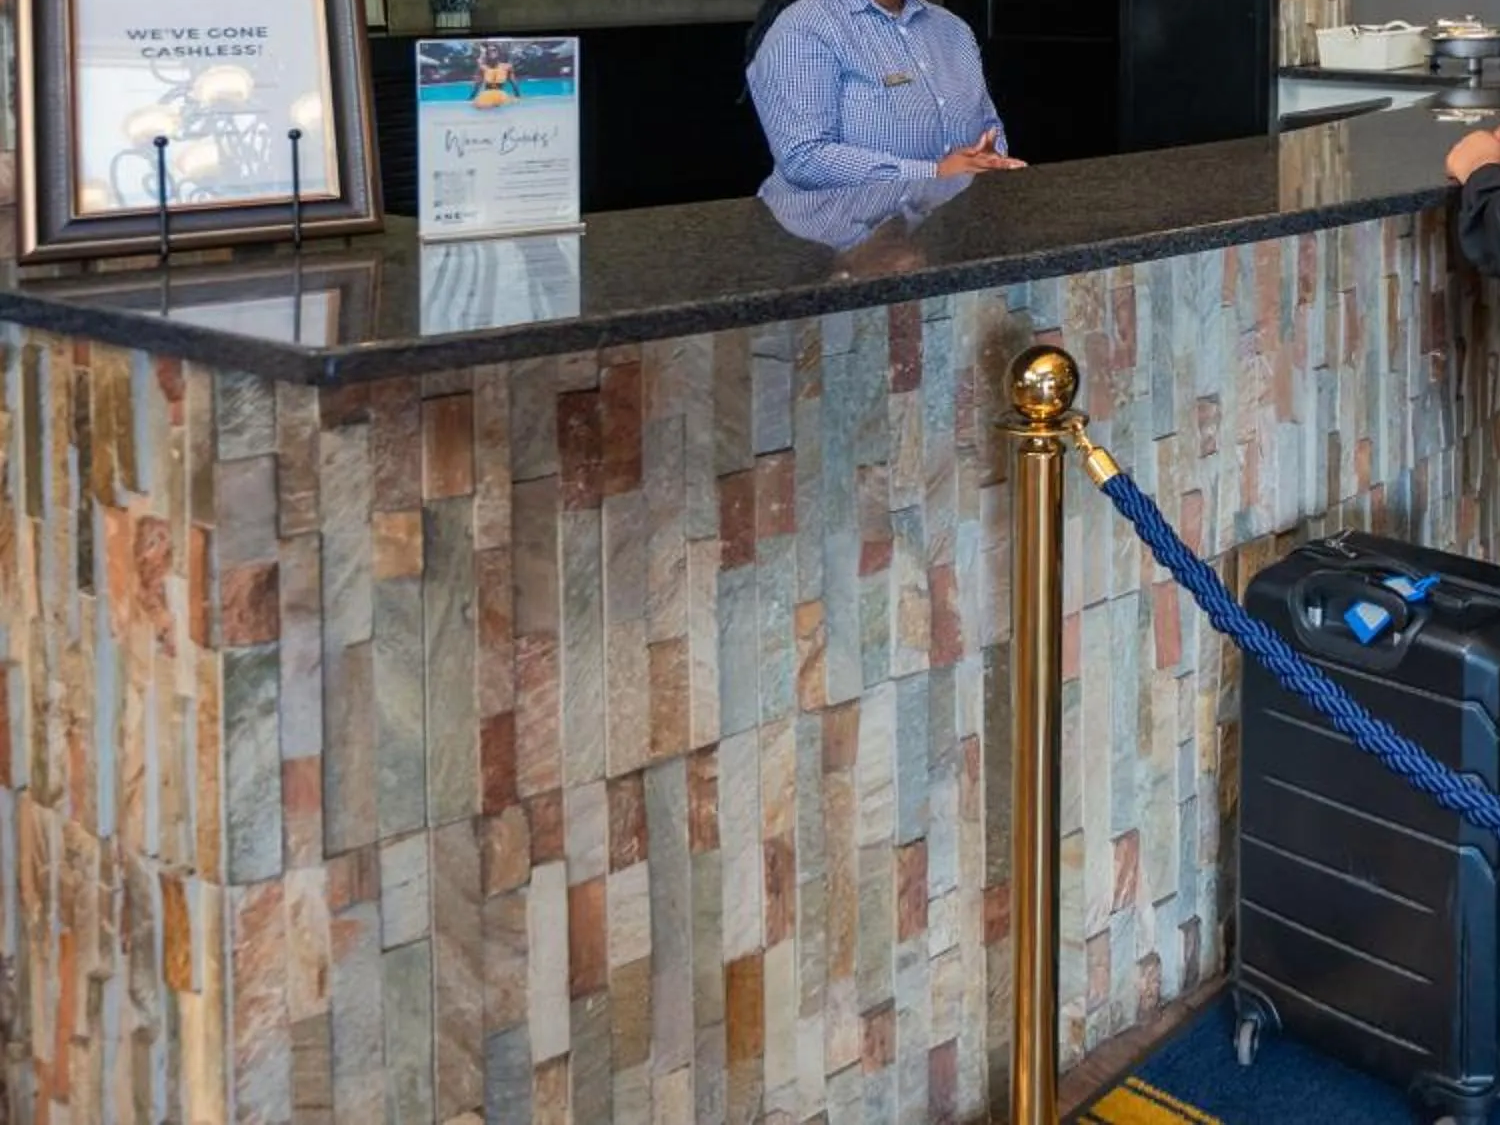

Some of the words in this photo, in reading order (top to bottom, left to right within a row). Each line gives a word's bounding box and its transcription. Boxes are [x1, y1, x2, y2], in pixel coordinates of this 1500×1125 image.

[126, 27, 201, 41] WE'VE
[206, 26, 269, 39] GONE
[141, 44, 263, 59] CASHLESS!
